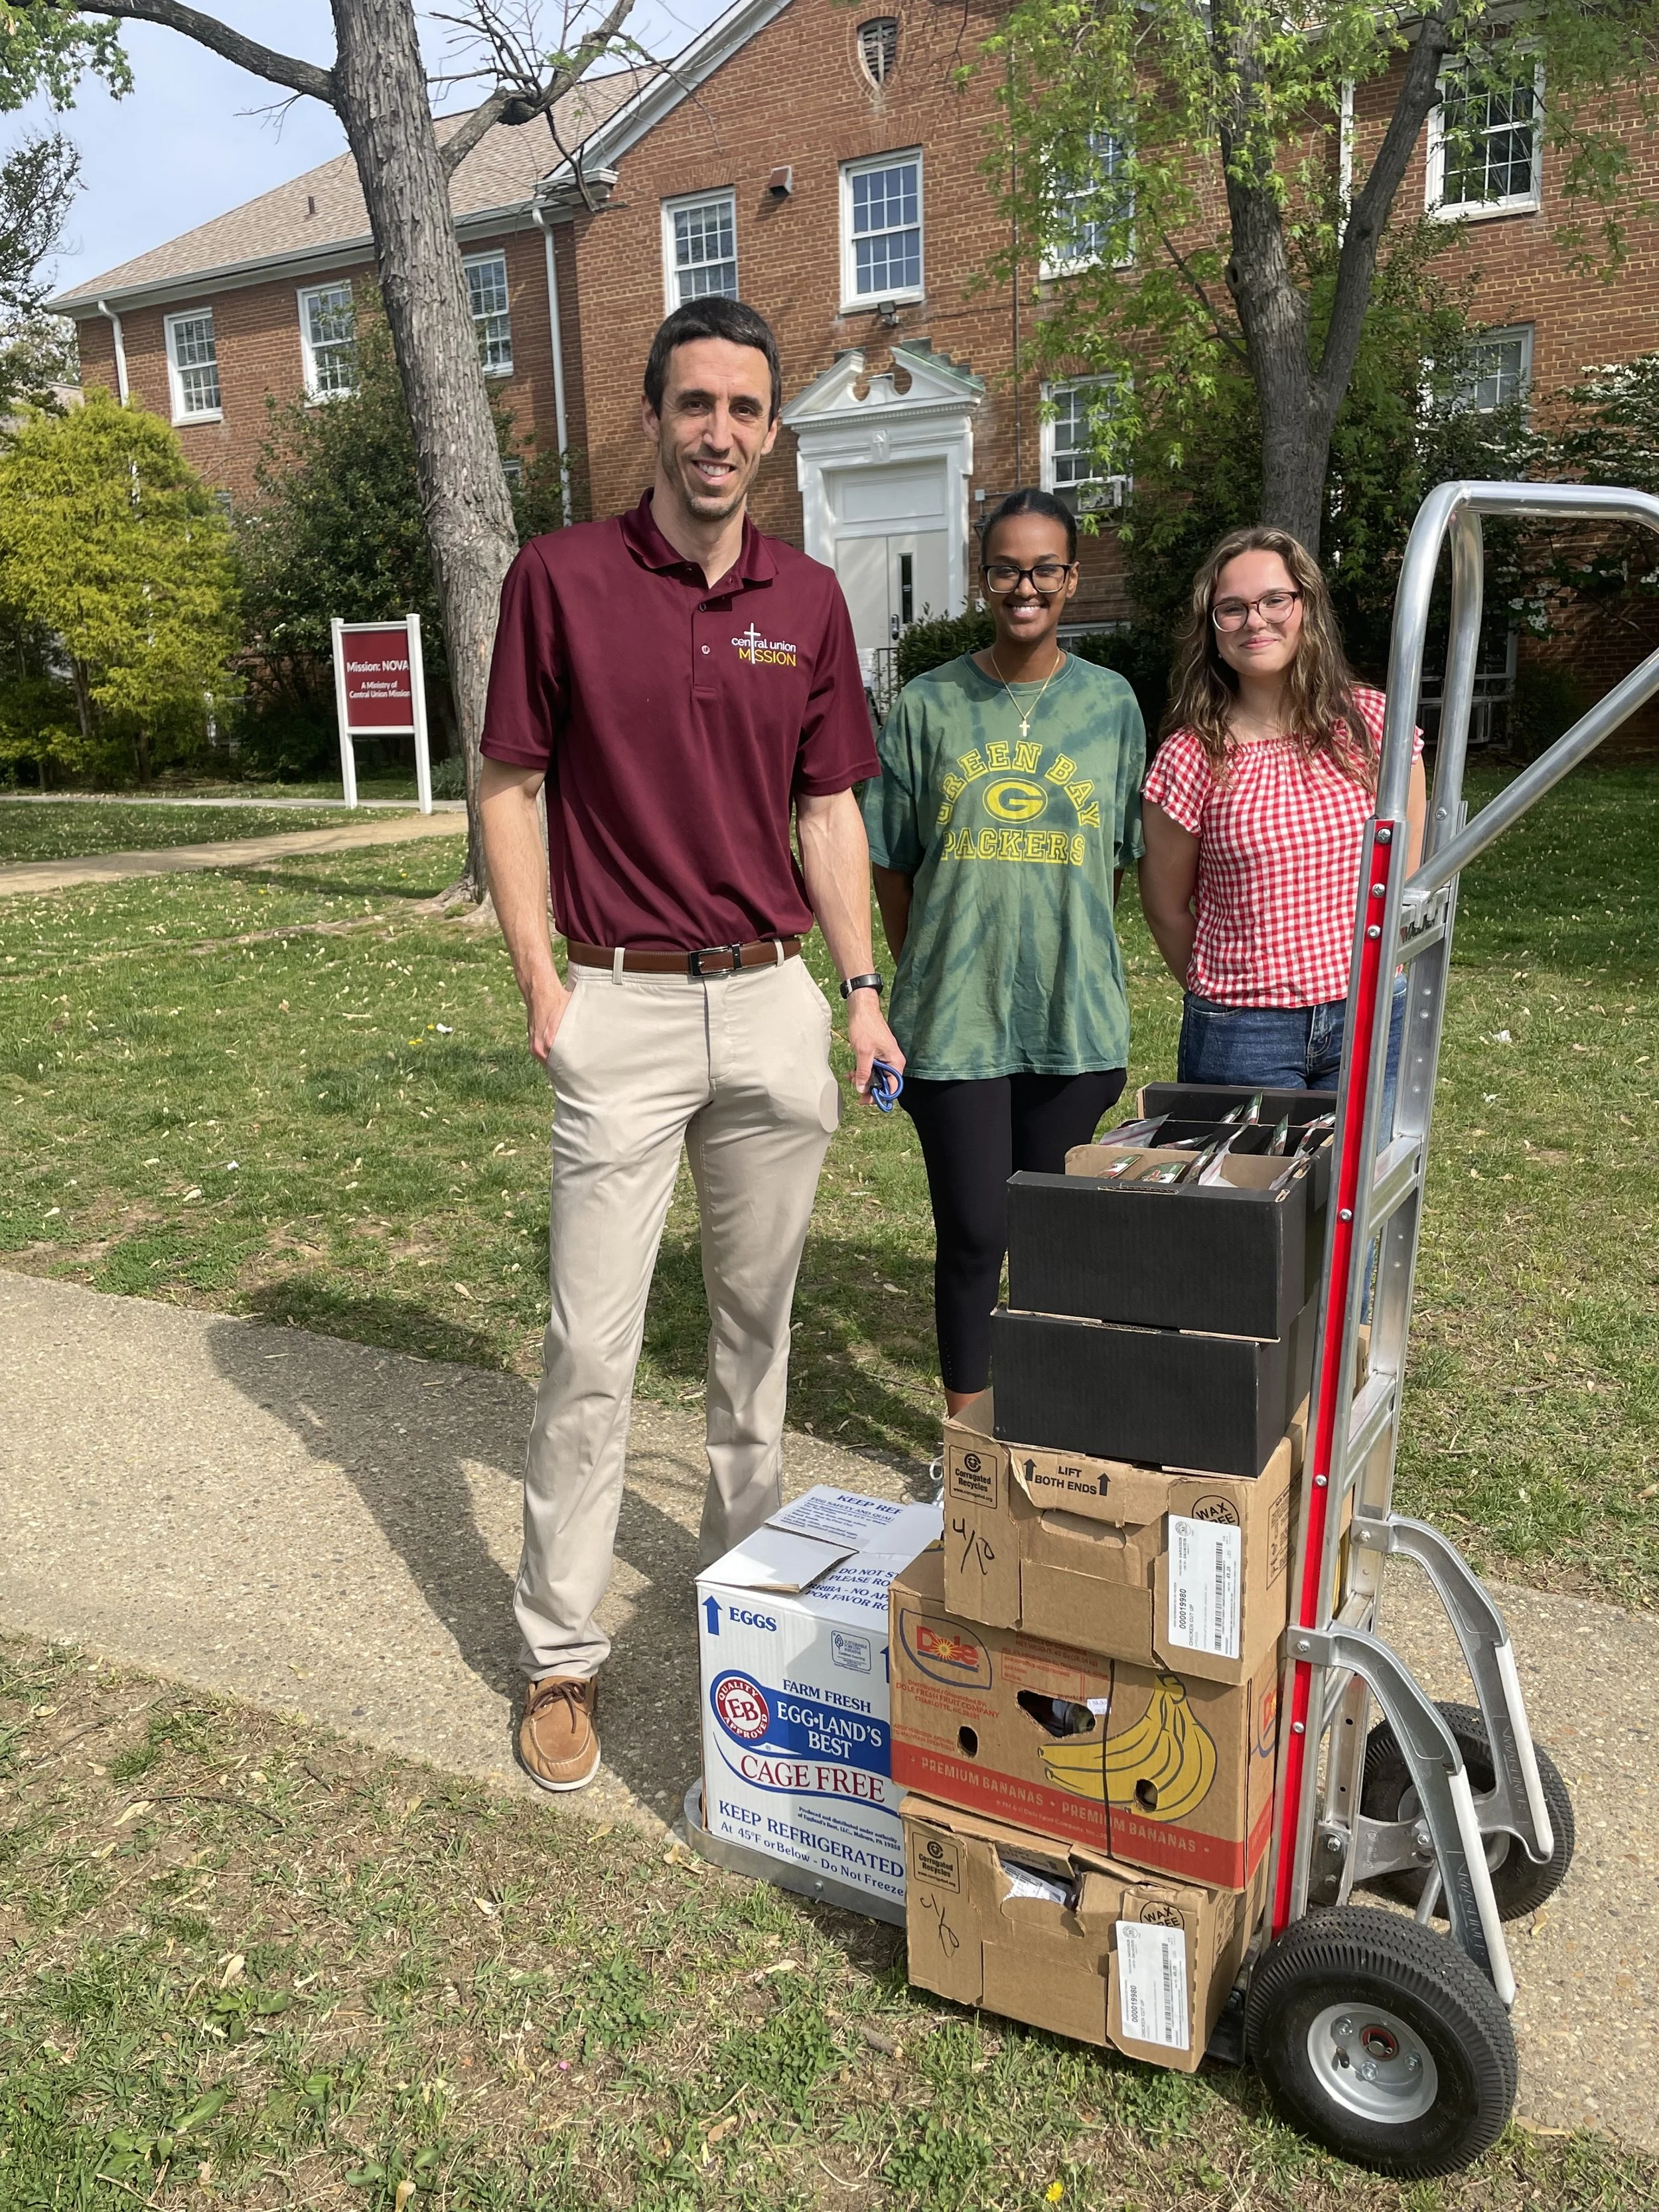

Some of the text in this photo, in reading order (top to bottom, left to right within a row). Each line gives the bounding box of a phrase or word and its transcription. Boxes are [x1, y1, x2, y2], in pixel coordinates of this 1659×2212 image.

[770, 640, 796, 652] union
[346, 660, 409, 673] Mission: NOVA
[739, 647, 796, 667] MISSION
[366, 681, 390, 690] Ministry
[985, 780, 1045, 820] G
[1044, 753, 1100, 828] BAY
[955, 1468, 991, 1485] Corrugated
[1058, 1465, 1082, 1478] LIFT
[958, 1477, 988, 1492] Recycles
[1035, 1475, 1098, 1495] BOTH ENDS
[837, 1495, 875, 1507] KEEP
[953, 1487, 993, 1503] www.corrugated.org
[828, 1501, 855, 1510] SAFETY
[1196, 1502, 1228, 1520] WAX
[828, 1575, 891, 1587] PLEASE RO
[805, 1590, 830, 1599] POR
[831, 1594, 871, 1607] FAVOR
[871, 1592, 889, 1601] AP
[729, 1607, 777, 1632] EGGS
[916, 1625, 979, 1665] Dole
[718, 1681, 758, 1701] QUALITY
[782, 1678, 871, 1714] FARM FRESH
[896, 1682, 1000, 1719] DOLE FRESH FRUIT COMPANY
[908, 1679, 940, 1693] Distributed
[944, 1690, 977, 1704] Dispatched
[727, 1698, 758, 1721] EB
[914, 1696, 952, 1712] CHARLOTTE,
[952, 1706, 962, 1715] NC
[723, 1714, 768, 1739] APPROVED
[808, 1730, 853, 1759] BEST
[741, 1755, 885, 1803] CAGE FREE
[921, 1756, 1196, 1852] PREMIUM BANANAS PREMIUM BANANAS
[803, 1814, 826, 1826] Eggland's
[826, 1822, 839, 1831] Best,
[1023, 1808, 1039, 1818] Dole
[1039, 1812, 1054, 1822] Food
[799, 1806, 822, 1818] Produced
[831, 1816, 859, 1830] distributed
[859, 1827, 873, 1836] under
[875, 1832, 898, 1844] authority
[719, 1799, 904, 1878] KEEP REFRIGERATED
[721, 1821, 733, 1834] At
[737, 1828, 761, 1844] 45°F
[763, 1838, 776, 1850] or
[776, 1841, 810, 1863] Below
[821, 1858, 837, 1874] Do
[840, 1866, 861, 1882] Not
[864, 1873, 904, 1897] Freeze
[918, 1853, 954, 1872] Corrugated
[921, 1862, 952, 1878] Recycles
[1143, 1906, 1174, 1922] WAX
[1129, 1985, 1138, 2023] 000019980
